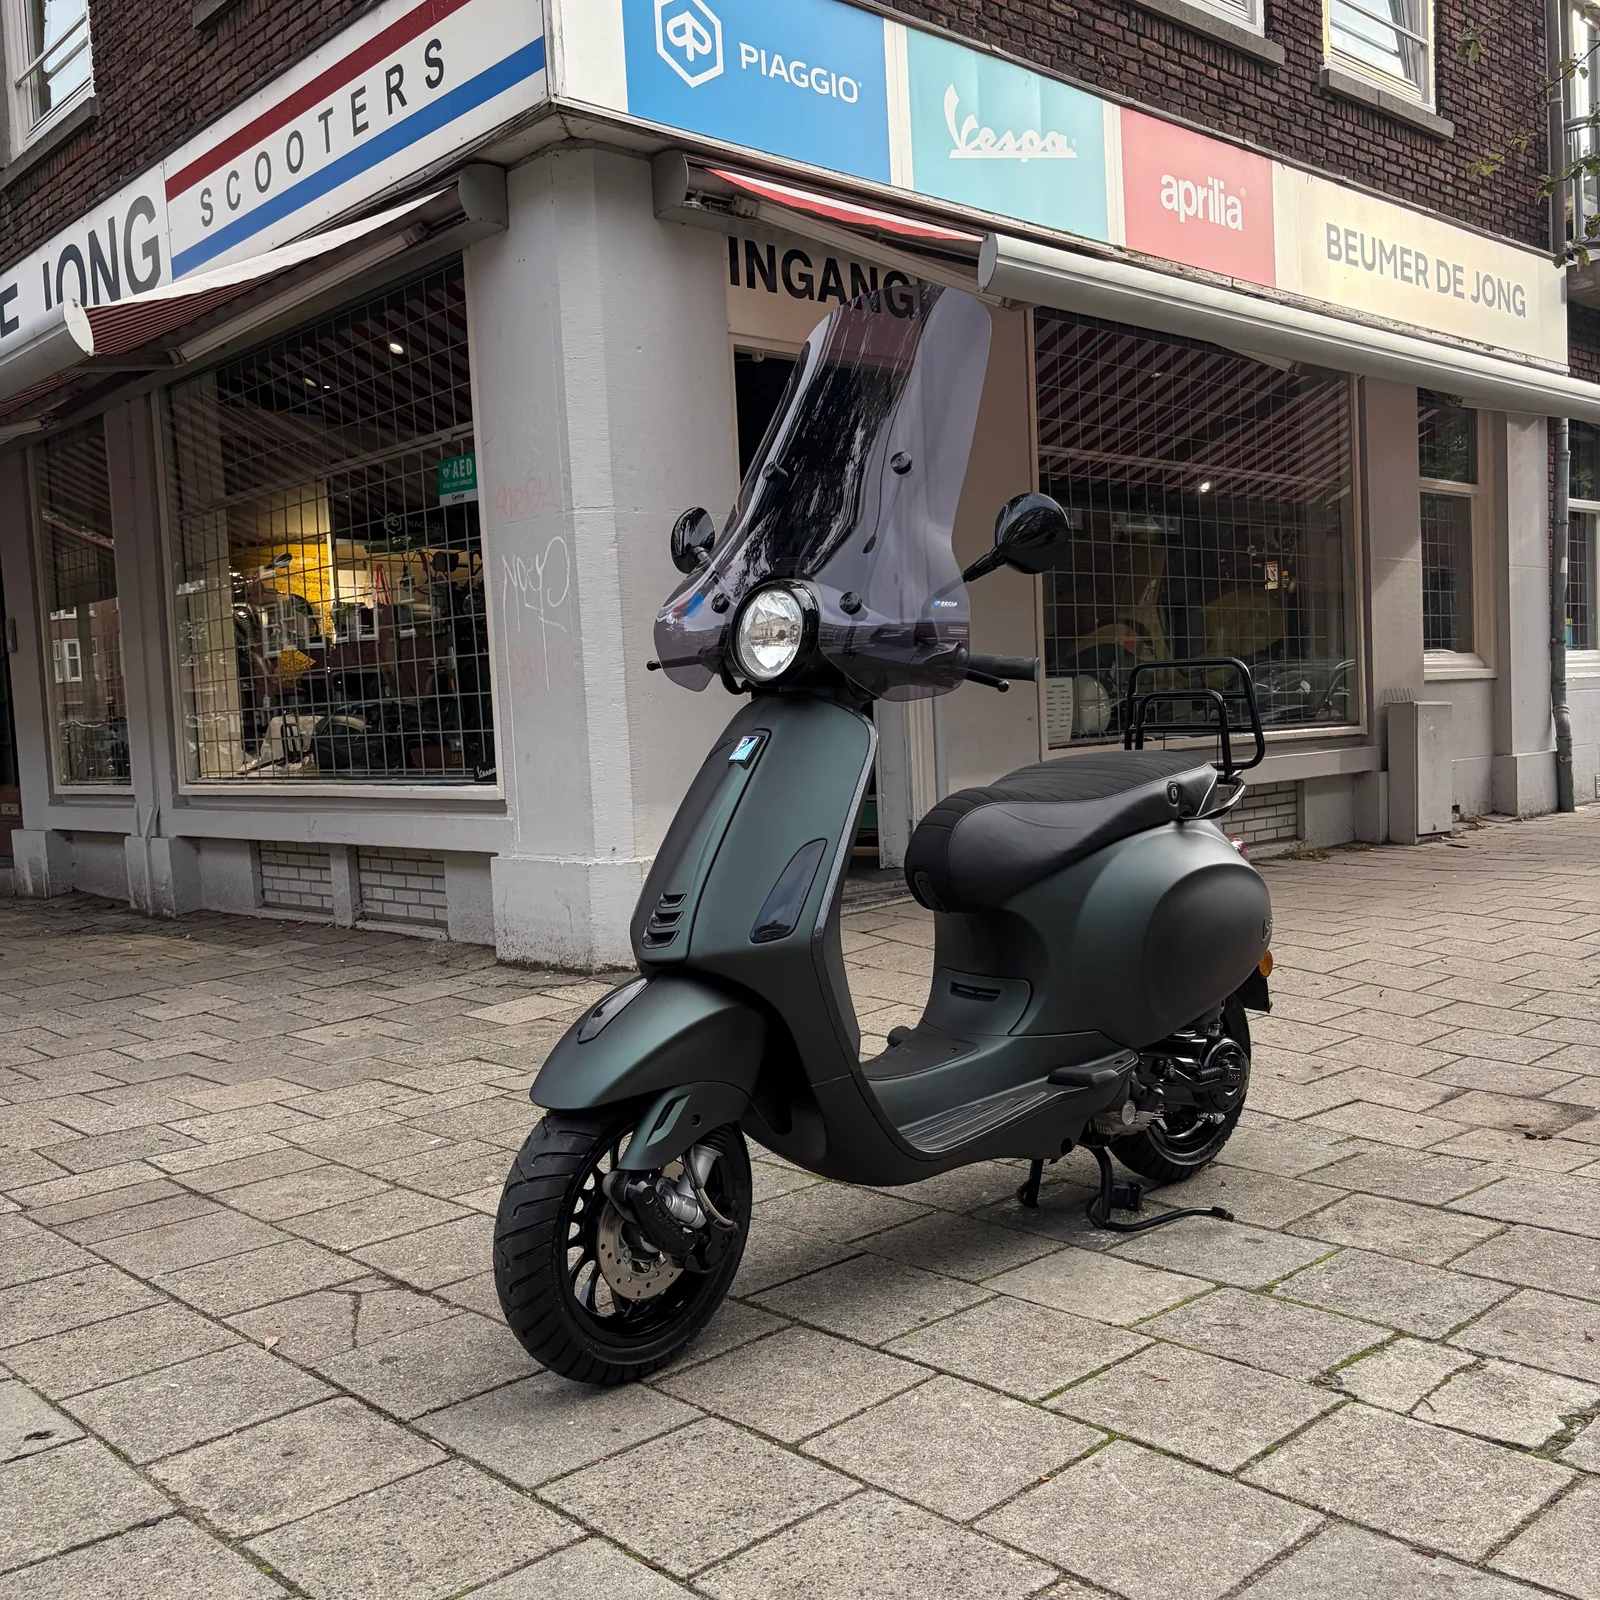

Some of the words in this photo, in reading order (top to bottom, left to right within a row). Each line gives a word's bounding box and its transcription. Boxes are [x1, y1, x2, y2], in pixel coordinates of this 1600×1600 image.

[738, 41, 859, 104] PIAGGIO
[200, 38, 445, 228] SCOOTERS
[943, 83, 1078, 163] Vespa
[1160, 173, 1243, 232] aprilia
[727, 235, 916, 320] INGANG
[1325, 222, 1430, 290] BEUMER
[1435, 258, 1466, 300] DE
[1470, 270, 1527, 319] JONG
[452, 458, 473, 479] AED
